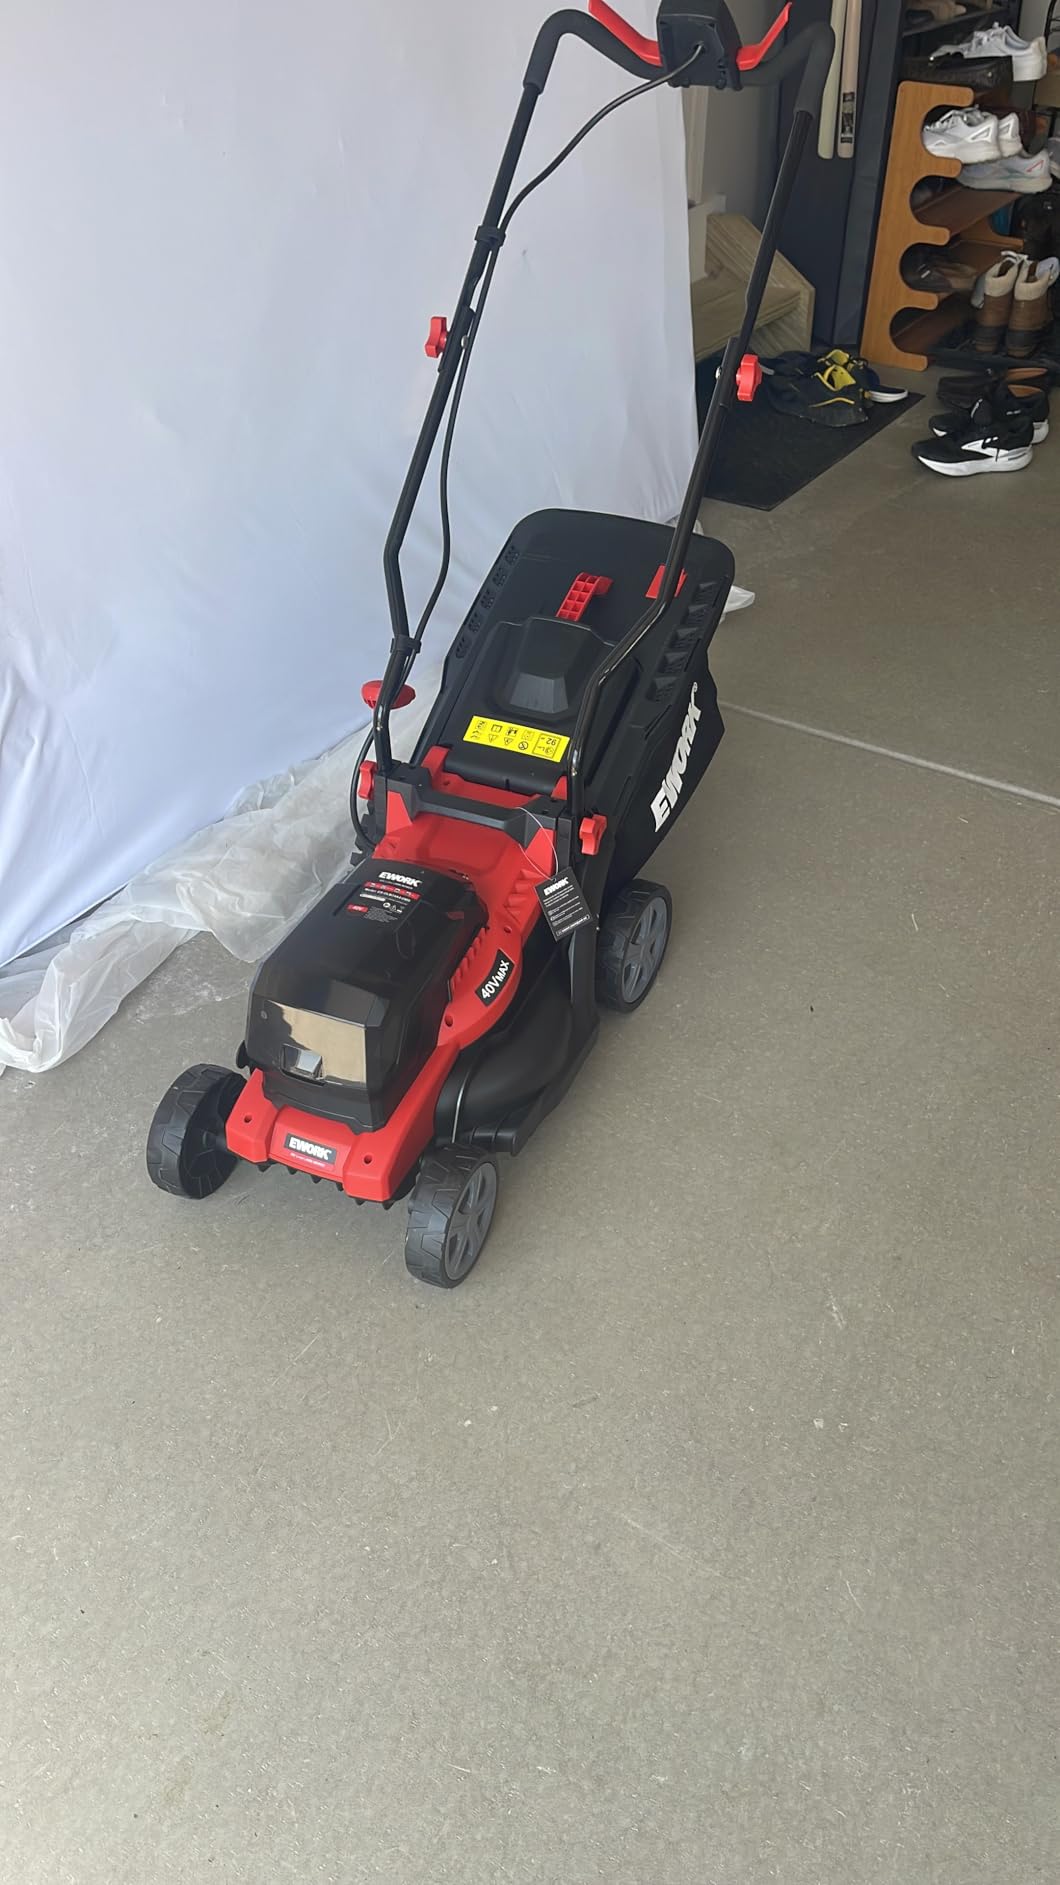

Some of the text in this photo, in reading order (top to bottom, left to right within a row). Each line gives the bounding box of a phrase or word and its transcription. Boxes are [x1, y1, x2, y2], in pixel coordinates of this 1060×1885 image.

[378, 871, 422, 887] EWORK
[543, 877, 569, 896] EWORK
[289, 1136, 332, 1160] EWORK
